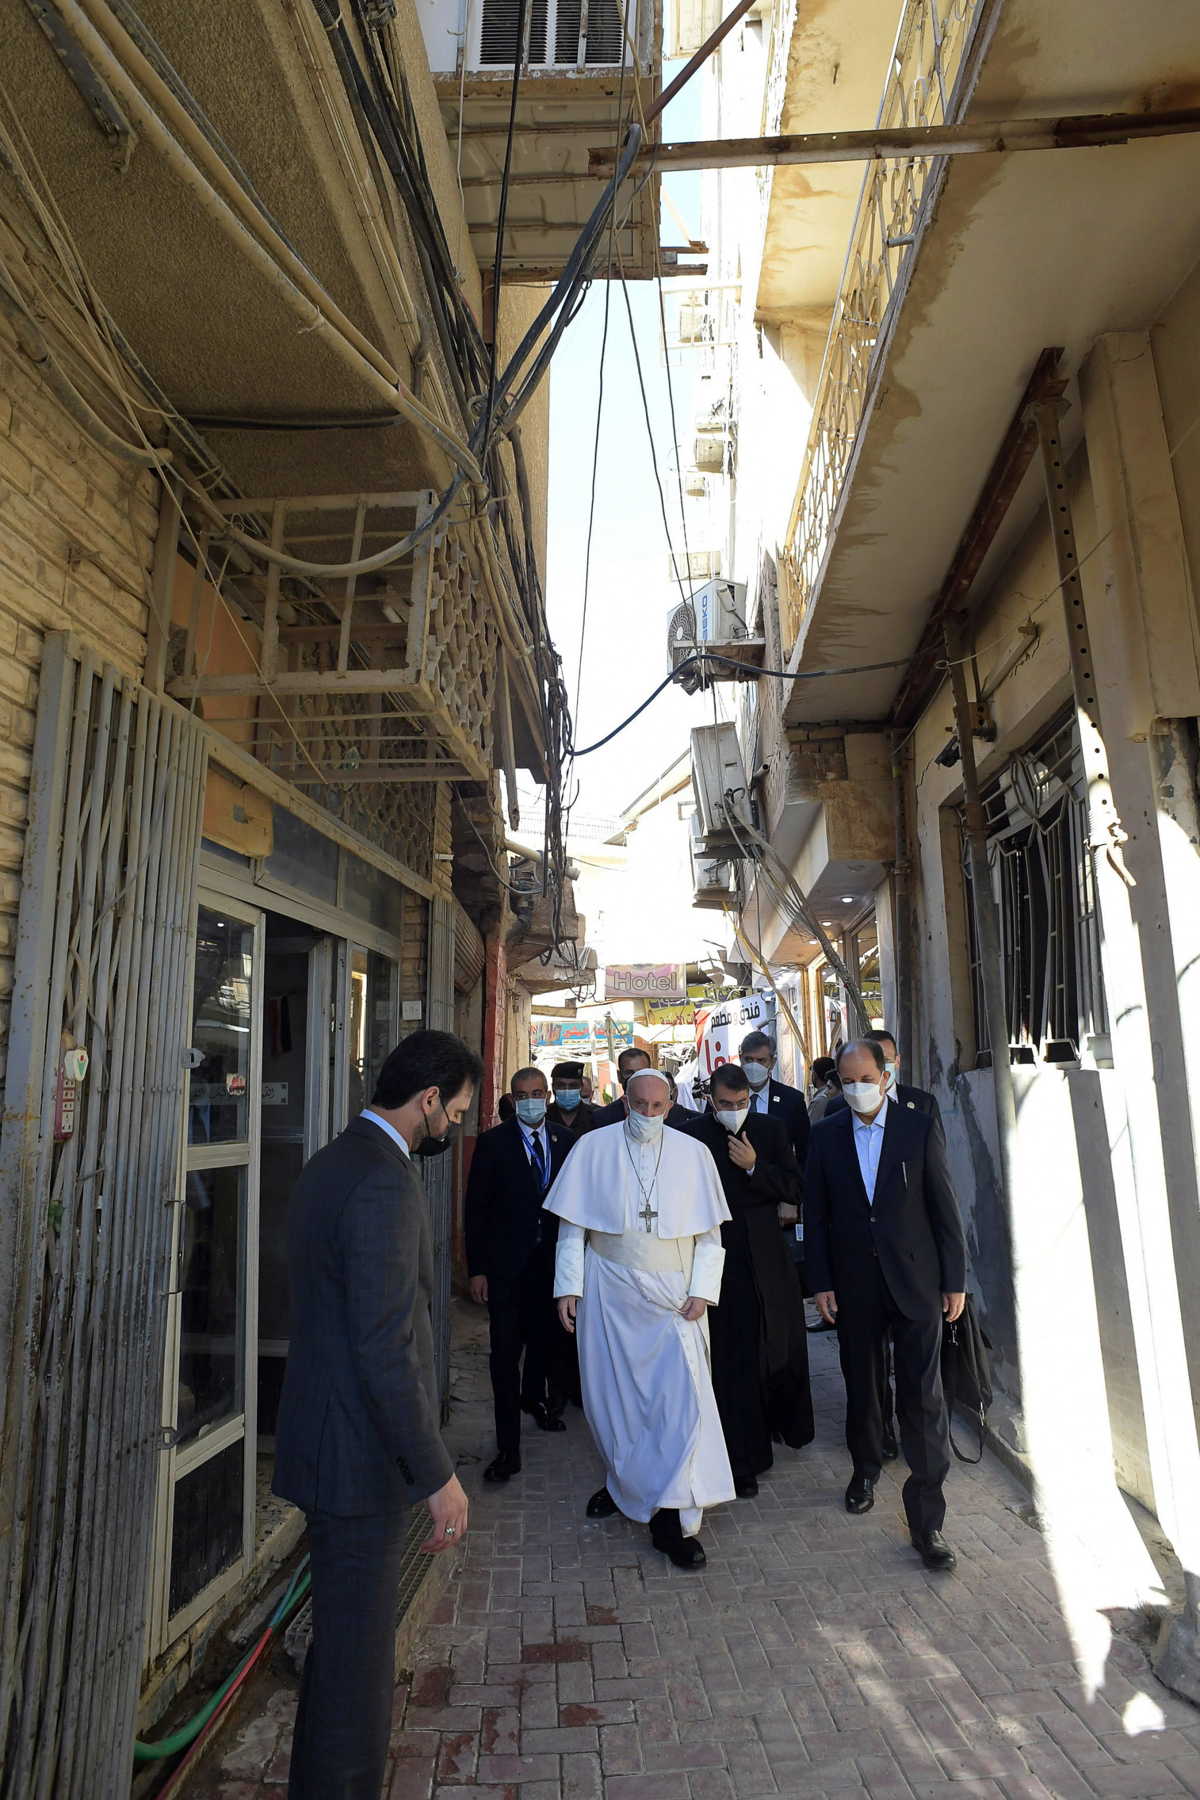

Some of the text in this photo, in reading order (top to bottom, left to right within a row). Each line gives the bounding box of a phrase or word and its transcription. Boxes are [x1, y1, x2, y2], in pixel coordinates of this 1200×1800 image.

[613, 971, 677, 991] Hotel
[710, 1011, 733, 1033] مطعم
[739, 1001, 760, 1026] فندق
